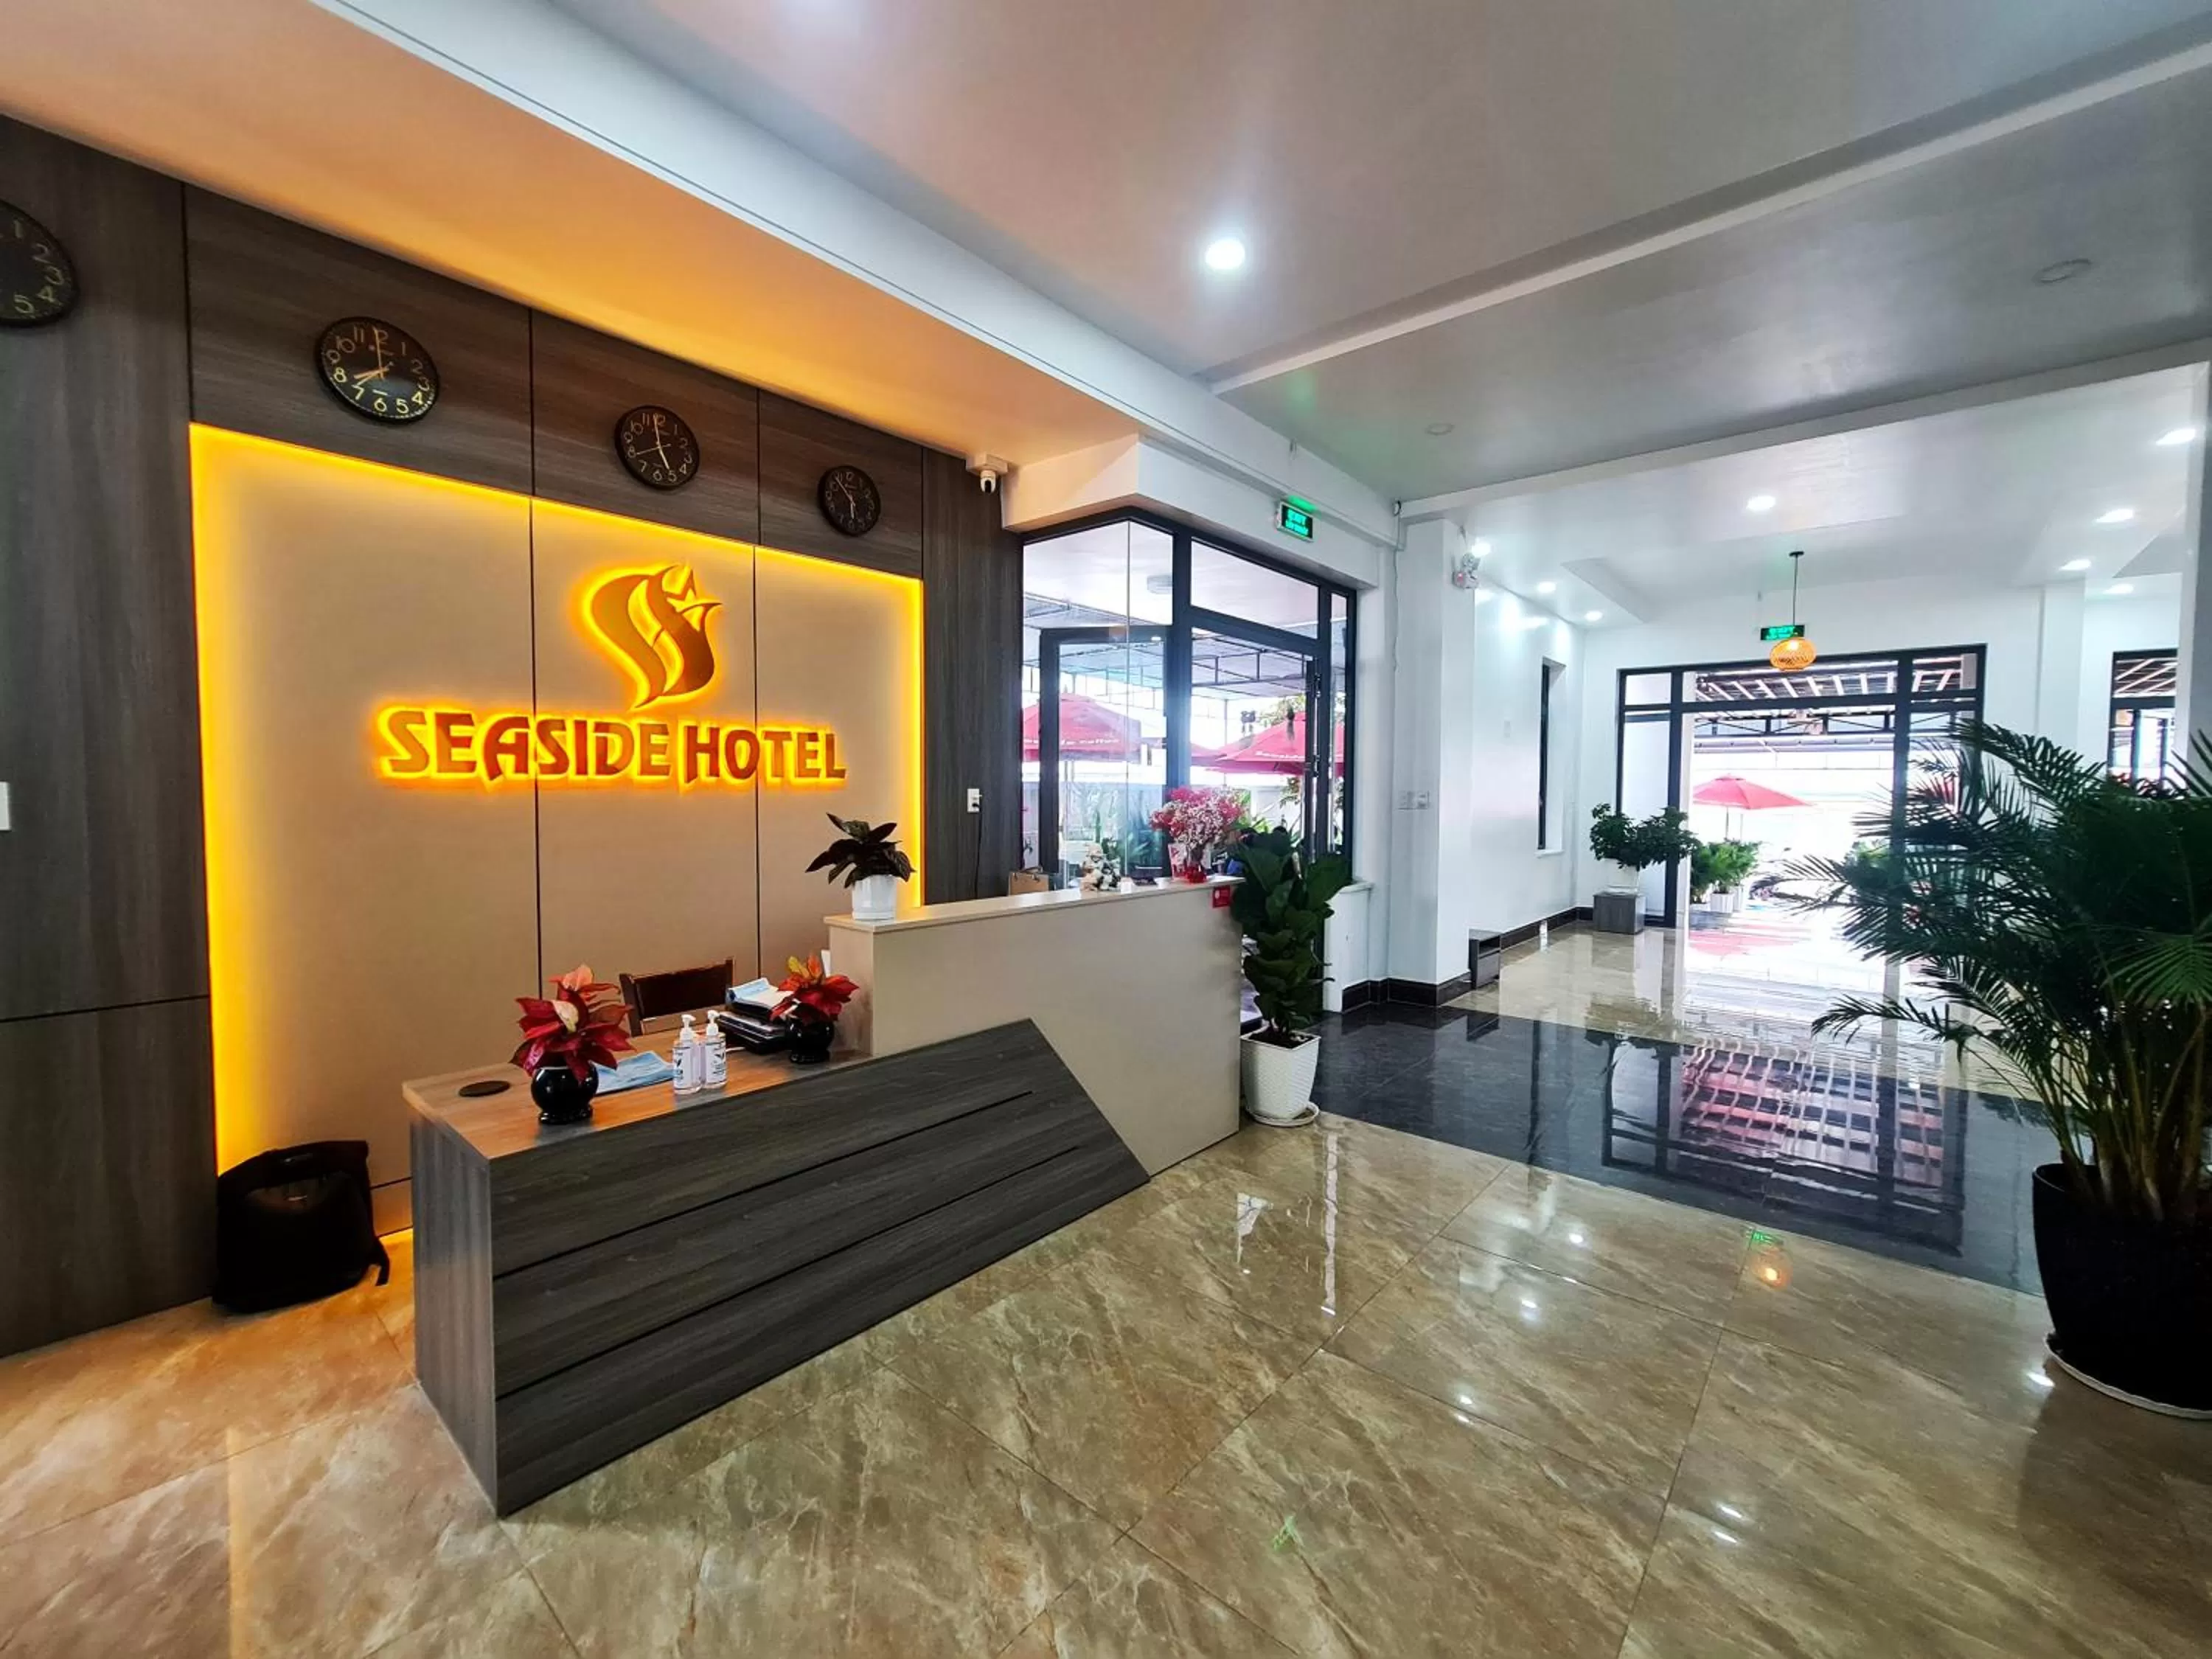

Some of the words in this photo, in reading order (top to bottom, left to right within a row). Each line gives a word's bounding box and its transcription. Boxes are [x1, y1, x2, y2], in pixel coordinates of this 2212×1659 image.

[13, 292, 35, 314] 5
[326, 349, 341, 364] 9
[411, 359, 423, 375] 2
[333, 367, 347, 383] 8
[352, 384, 364, 400] 7
[417, 377, 430, 392] 3
[374, 398, 387, 412] 6
[411, 391, 423, 405] 4
[396, 398, 409, 414] 5
[624, 431, 633, 444] 9
[628, 445, 636, 458] 8
[653, 469, 662, 481] 6
[679, 463, 686, 474] 4
[386, 710, 671, 782] SEASIDE
[683, 725, 847, 784] HOTEL
